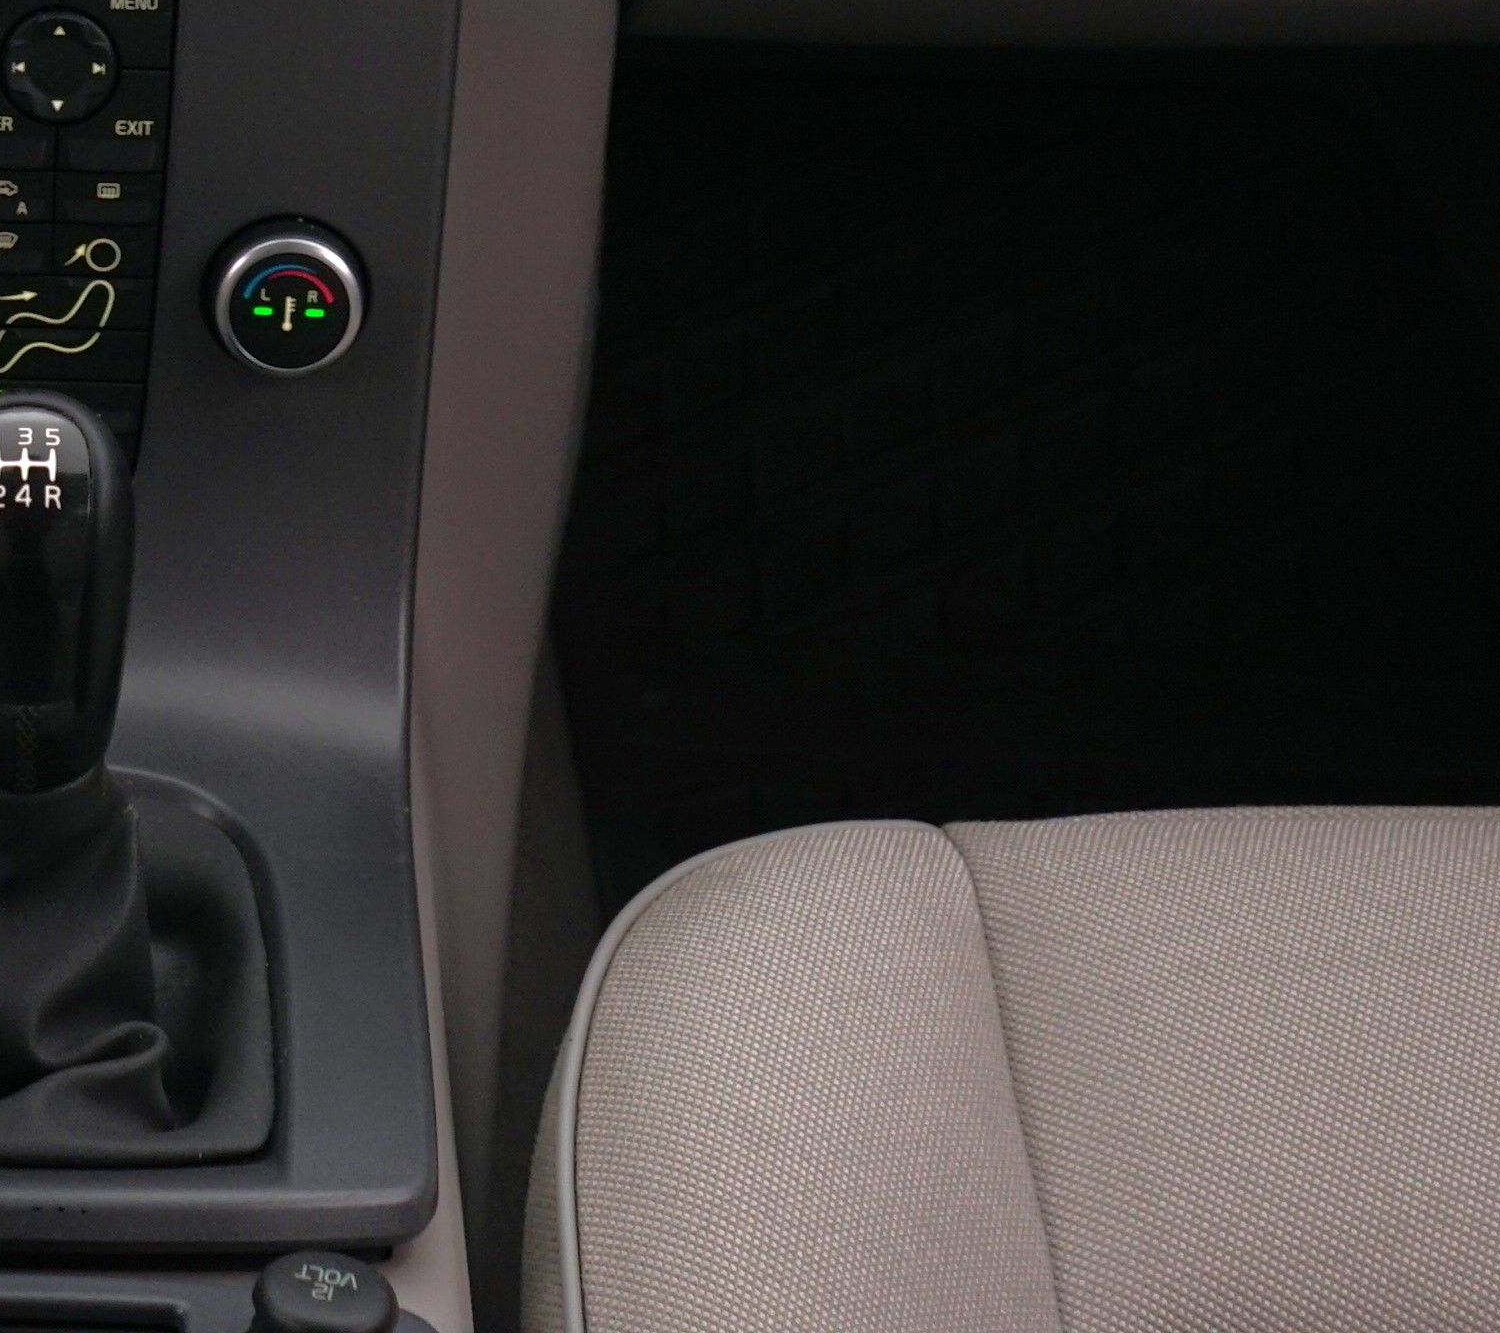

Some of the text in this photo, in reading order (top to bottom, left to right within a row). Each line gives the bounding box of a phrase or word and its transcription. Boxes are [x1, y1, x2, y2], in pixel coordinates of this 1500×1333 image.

[114, 119, 155, 136] EXIT
[16, 201, 28, 215] A
[260, 288, 271, 302] L
[306, 290, 320, 304] R
[17, 427, 33, 446] 3
[45, 427, 61, 446] 5
[14, 483, 33, 508] 4
[44, 484, 62, 510] R
[293, 1261, 360, 1293] VOLT
[309, 1281, 336, 1303] 12
